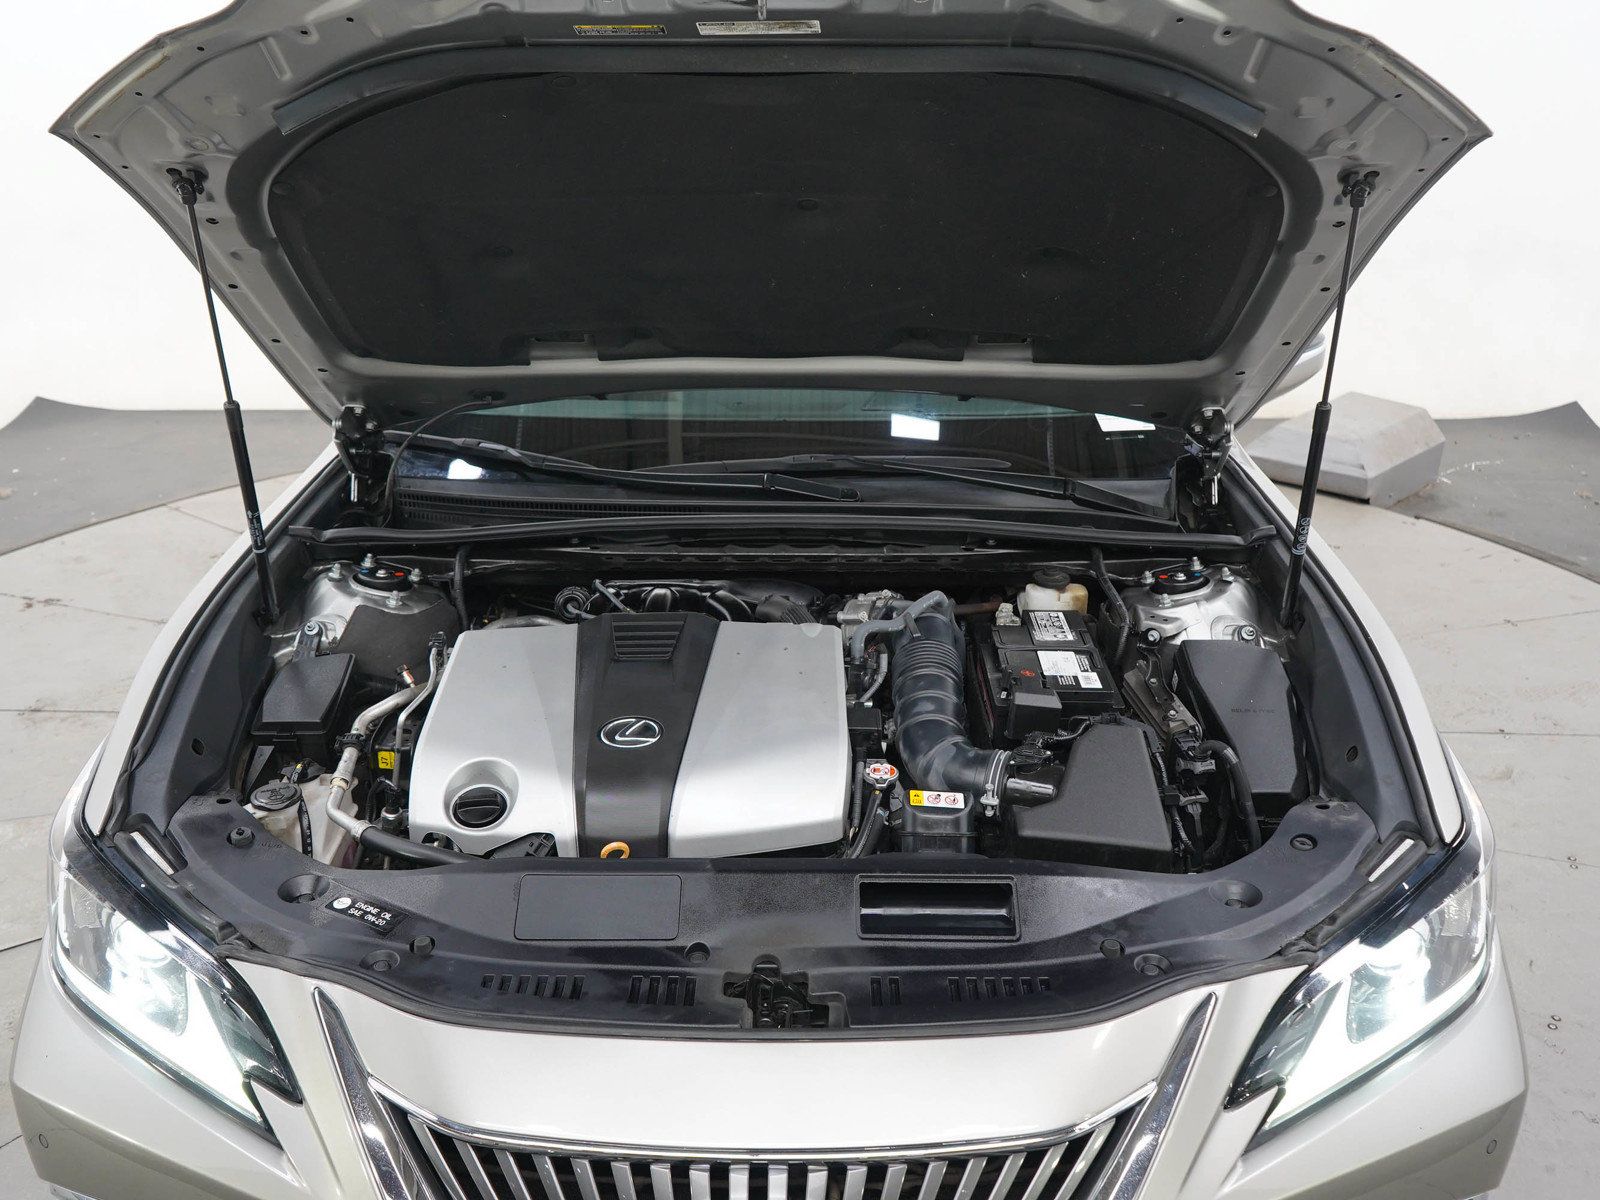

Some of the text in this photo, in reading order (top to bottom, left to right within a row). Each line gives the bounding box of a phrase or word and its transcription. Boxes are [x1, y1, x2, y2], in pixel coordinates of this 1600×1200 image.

[347, 907, 364, 917] SAE
[354, 901, 392, 920] ENGINE OIL
